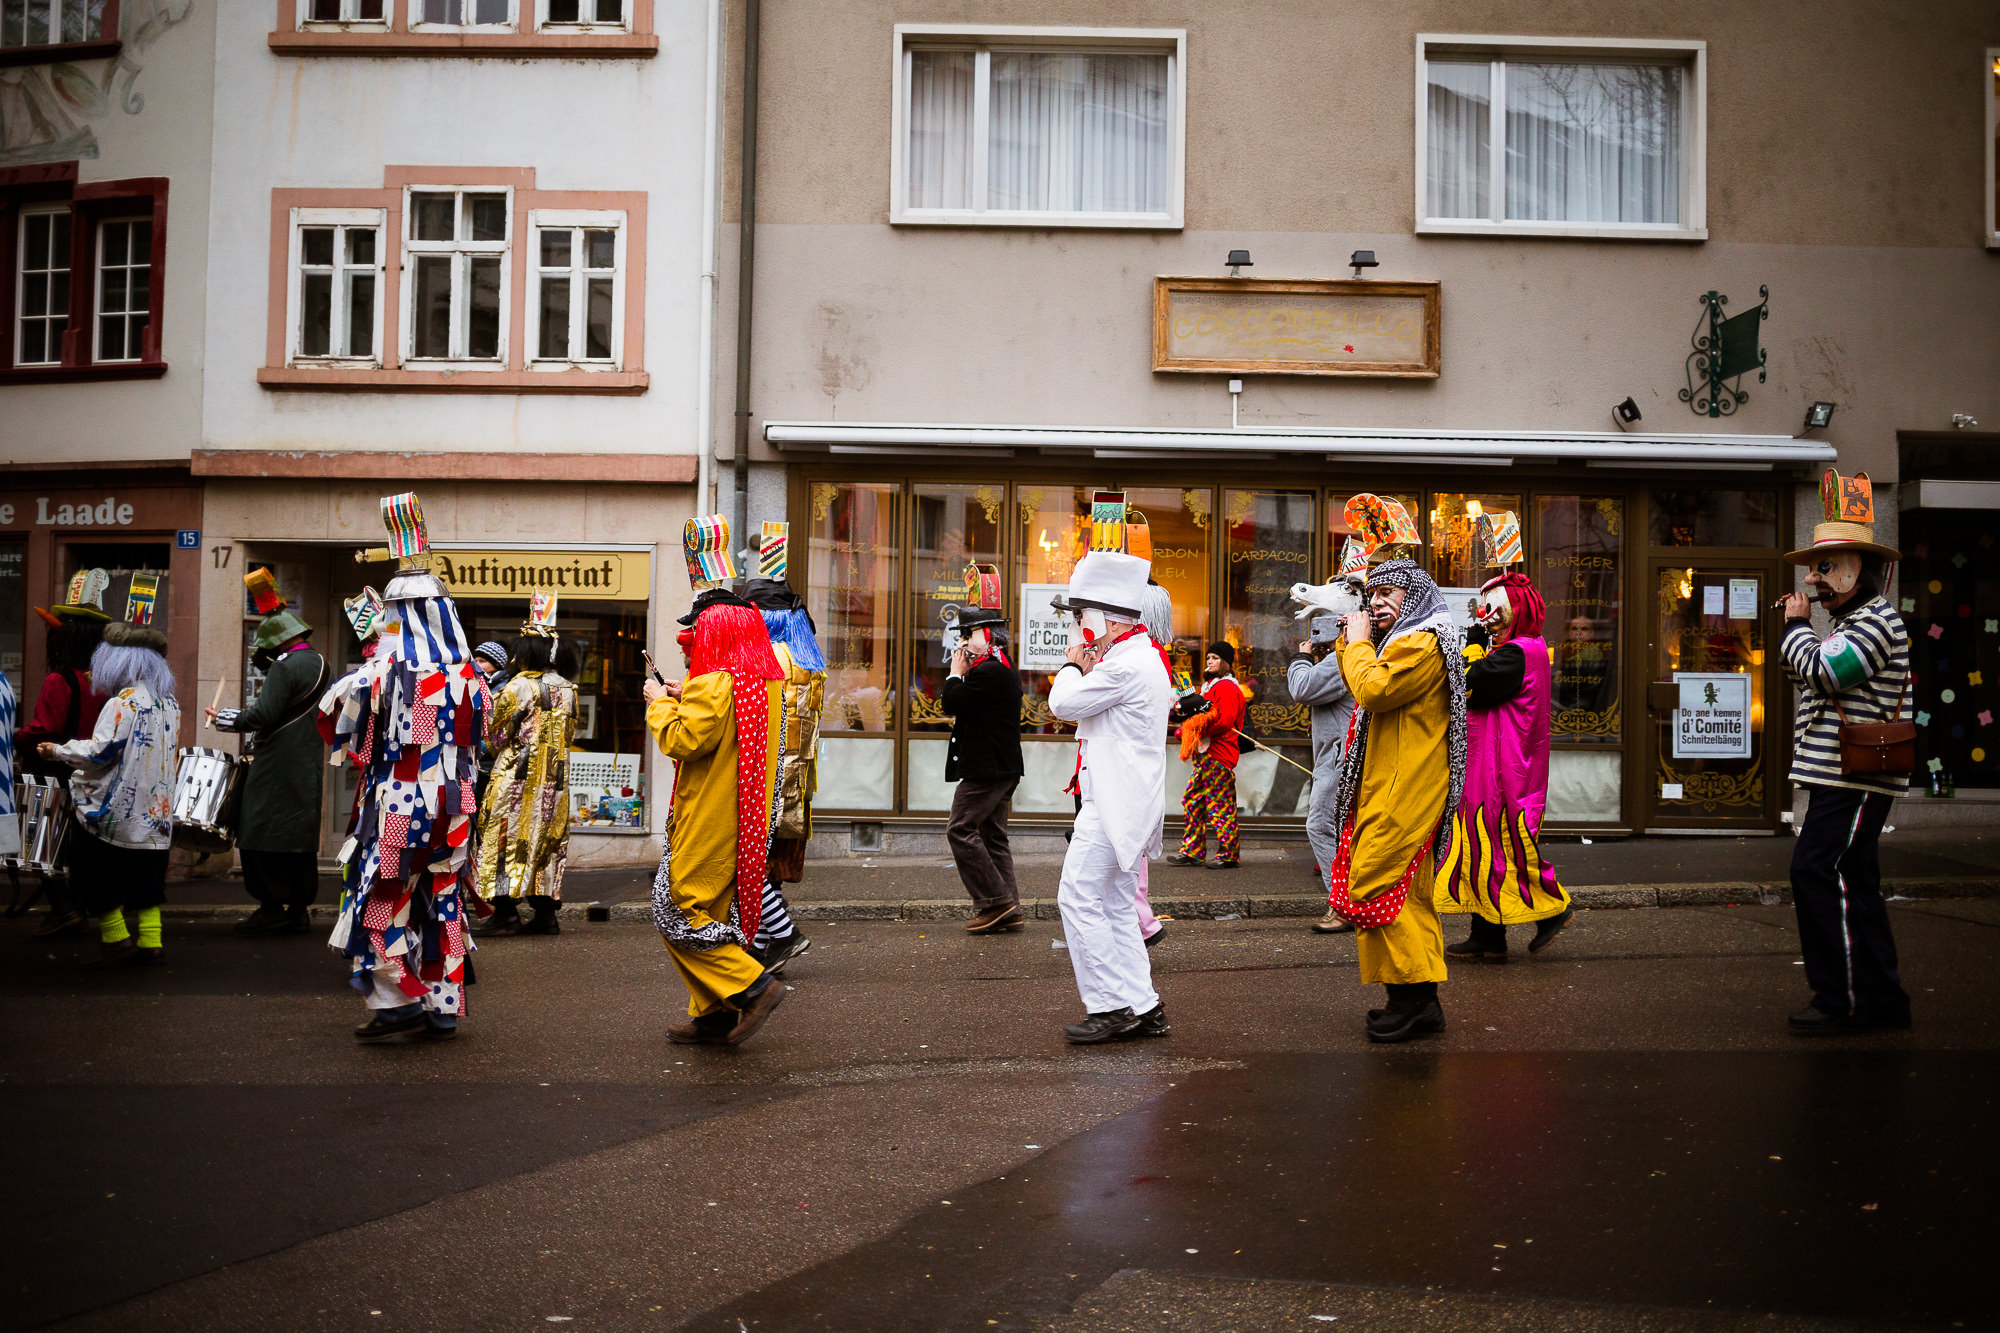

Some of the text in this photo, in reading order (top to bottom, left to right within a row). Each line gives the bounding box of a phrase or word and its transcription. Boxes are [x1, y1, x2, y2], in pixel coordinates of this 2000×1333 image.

[1173, 309, 1419, 341] COCCODRILLO
[35, 496, 135, 526] Laade
[182, 532, 196, 545] 15
[827, 541, 881, 554] PIZZA
[1152, 548, 1199, 560] RDON
[211, 546, 233, 569] 17
[1231, 549, 1308, 564] CARPACCIO
[1545, 556, 1615, 569] BURGER
[436, 555, 613, 592] Antiquariat
[1151, 567, 1188, 579] LEU
[1573, 573, 1586, 589] &
[1029, 619, 1040, 629] Do
[1043, 621, 1059, 629] ane
[1681, 708, 1742, 718] Do ane kemme
[1681, 718, 1742, 734] d'Comité
[1681, 735, 1742, 747] Schnitzelbängg
